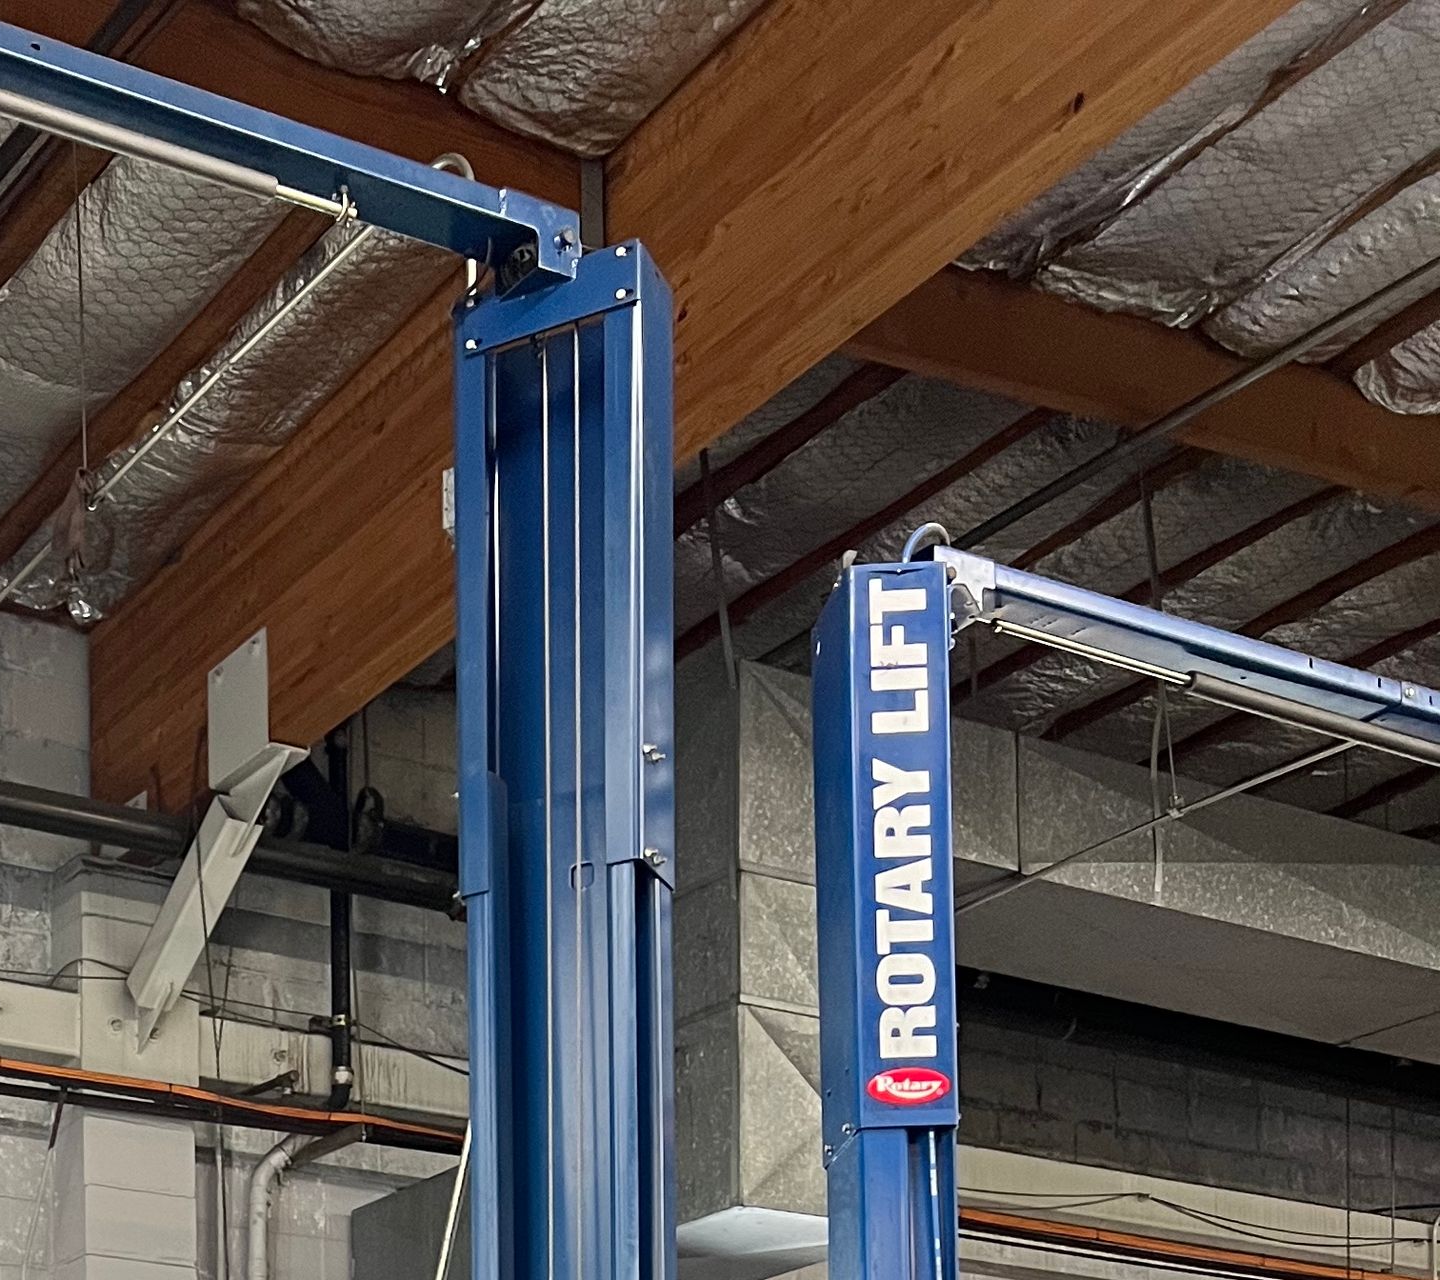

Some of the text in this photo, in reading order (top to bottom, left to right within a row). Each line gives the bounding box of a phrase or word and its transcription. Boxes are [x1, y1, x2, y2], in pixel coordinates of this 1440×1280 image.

[869, 578, 937, 1059] ROTARY LIFT
[875, 1074, 942, 1098] Rotary
